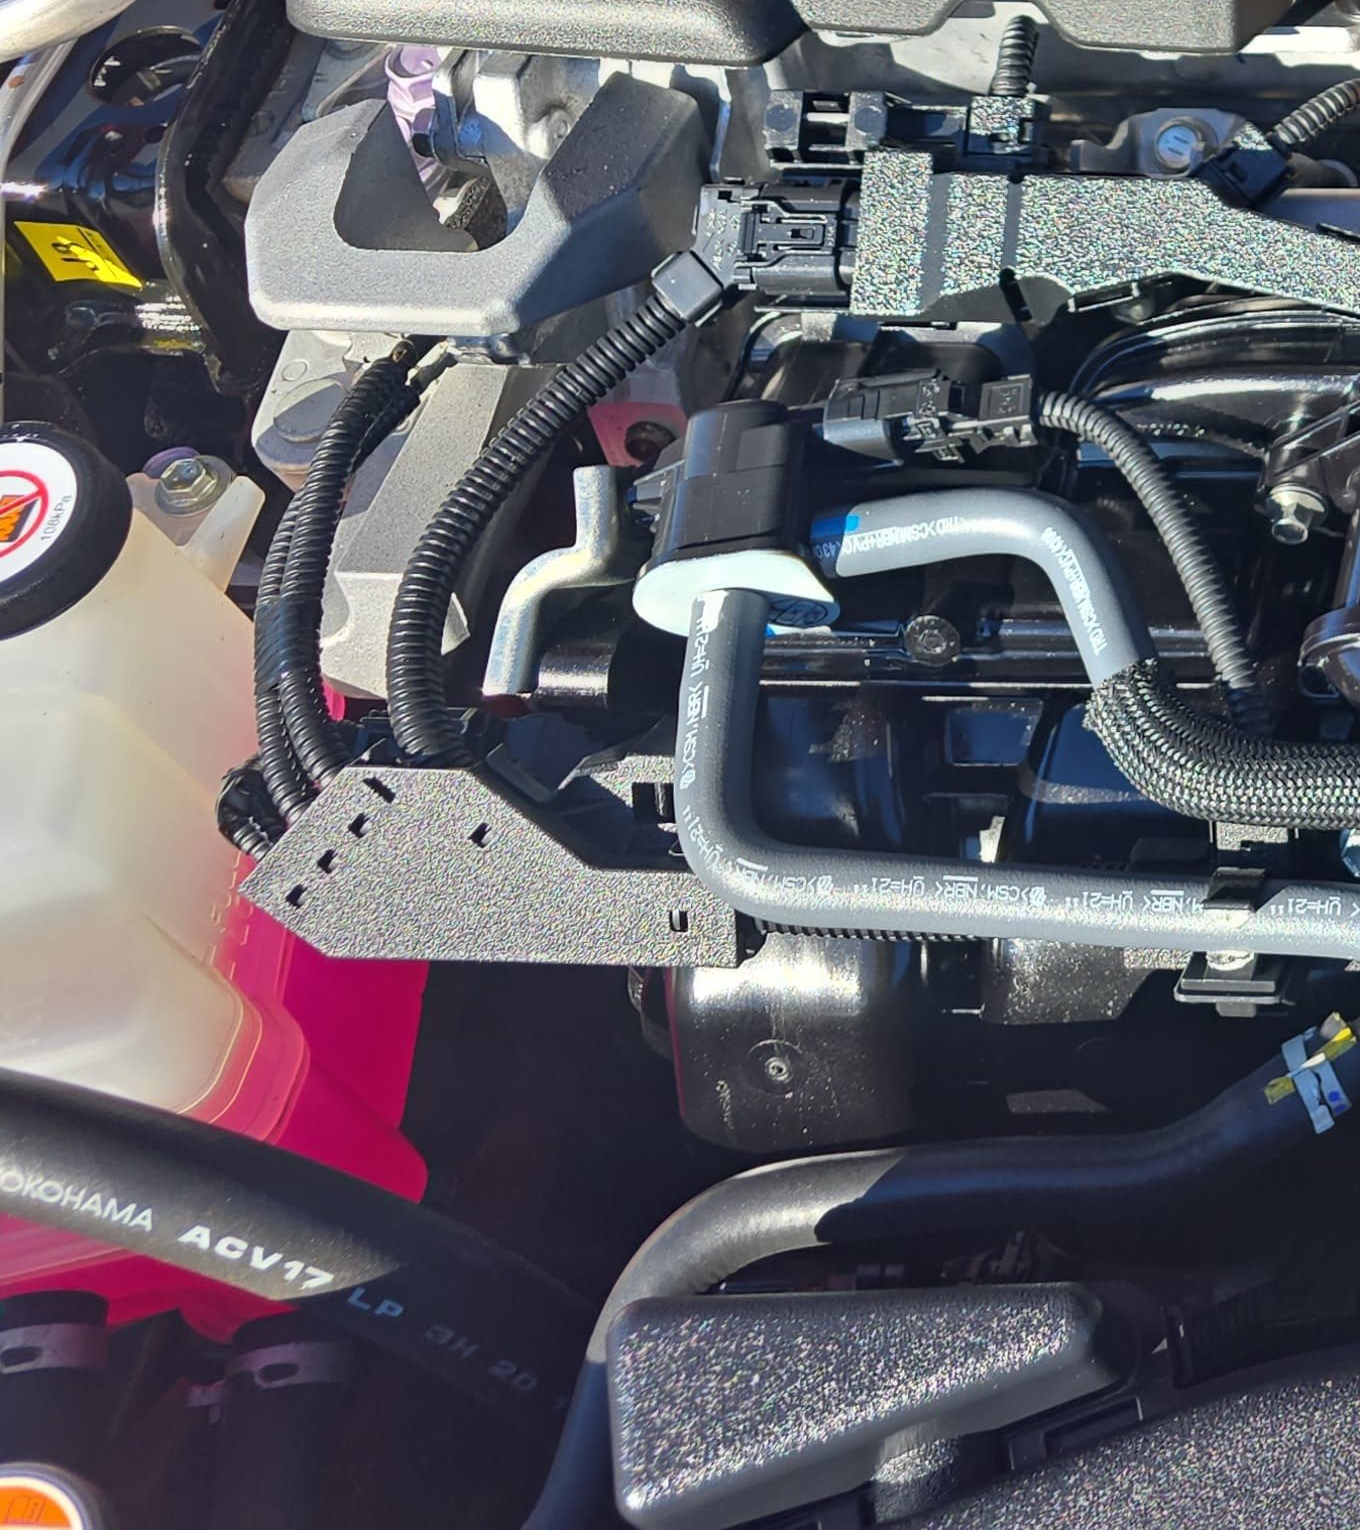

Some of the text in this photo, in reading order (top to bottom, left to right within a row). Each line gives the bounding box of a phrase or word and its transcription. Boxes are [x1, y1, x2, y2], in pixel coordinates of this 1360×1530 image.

[40, 495, 72, 542] 108kPa
[178, 1223, 334, 1290] ACV17
[347, 1286, 404, 1320] LP
